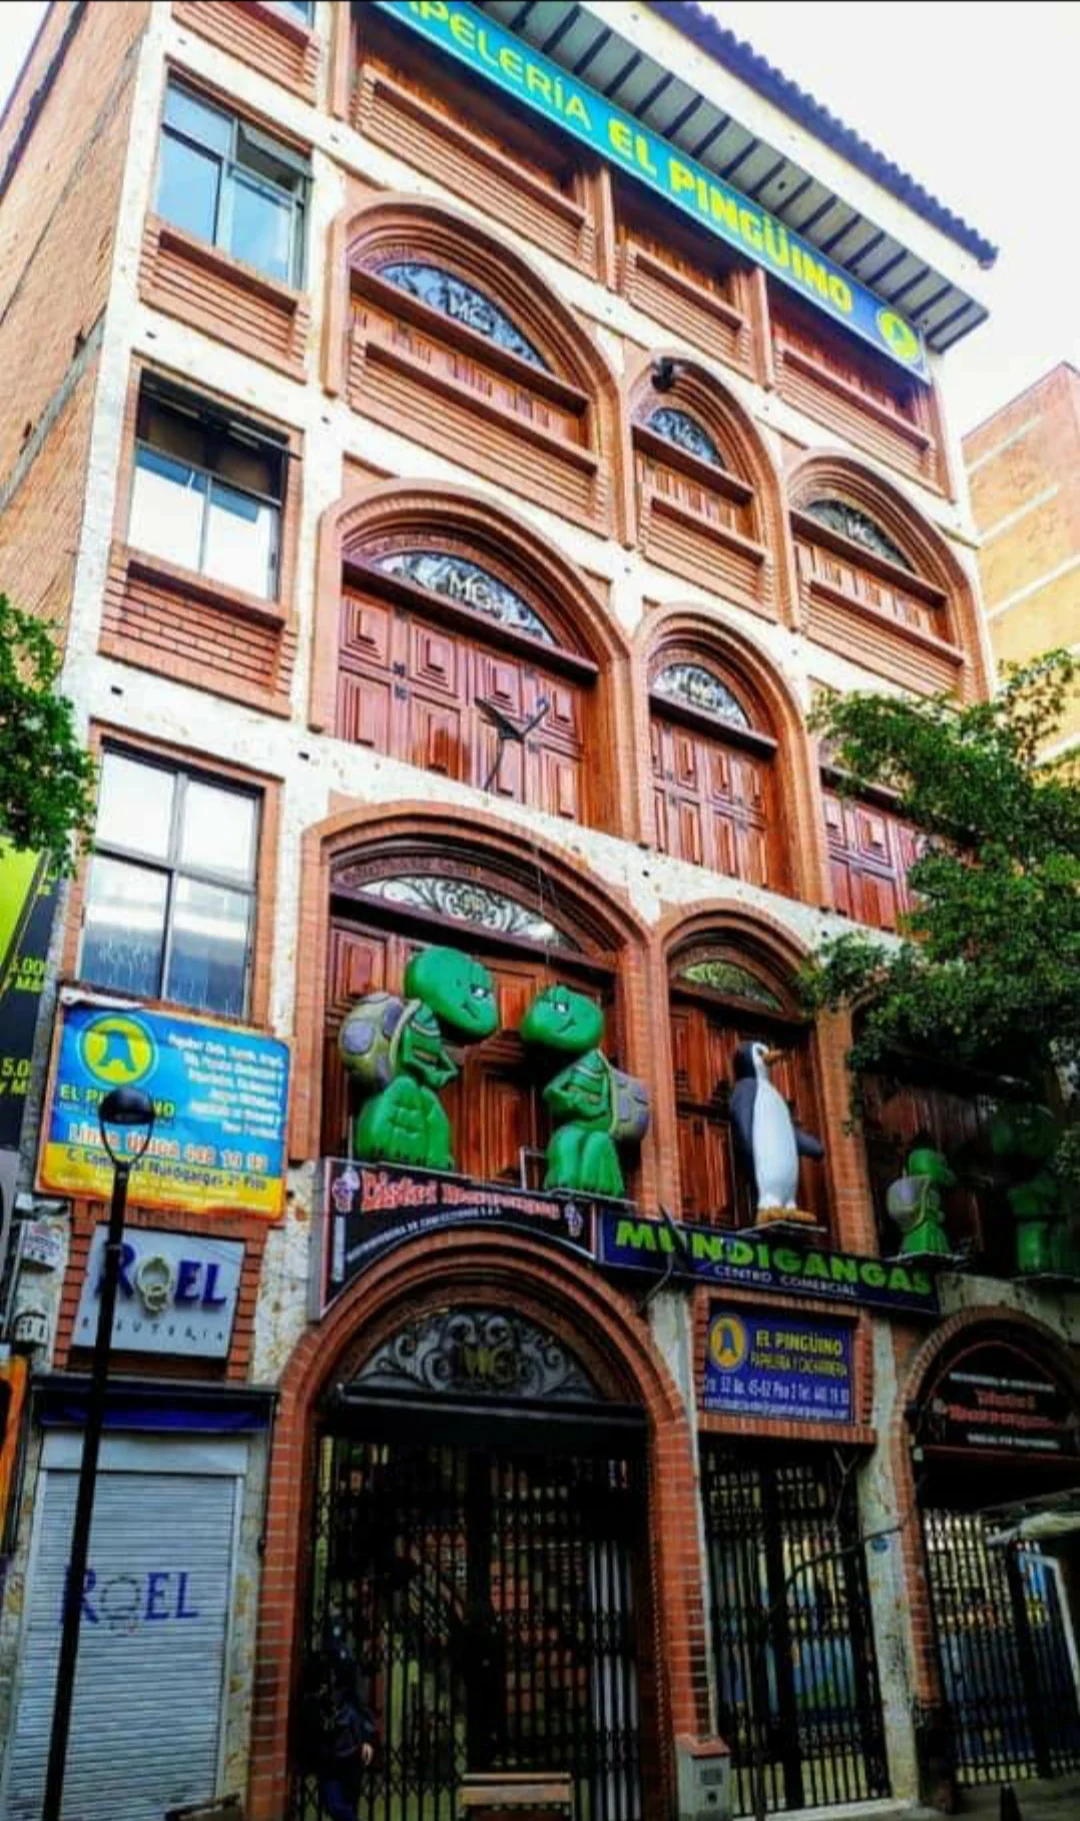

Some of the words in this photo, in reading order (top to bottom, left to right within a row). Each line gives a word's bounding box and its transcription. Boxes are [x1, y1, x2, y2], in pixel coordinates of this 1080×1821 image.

[409, 2, 593, 132] PELERÍA
[607, 118, 658, 176] EL
[668, 157, 854, 313] PINGÜINO
[60, 1083, 80, 1102] EL
[714, 1265, 772, 1284] CENTRO
[780, 1274, 856, 1297] COMERCIAL
[756, 1329, 769, 1347] EL
[775, 1331, 843, 1356] PINGÜINO
